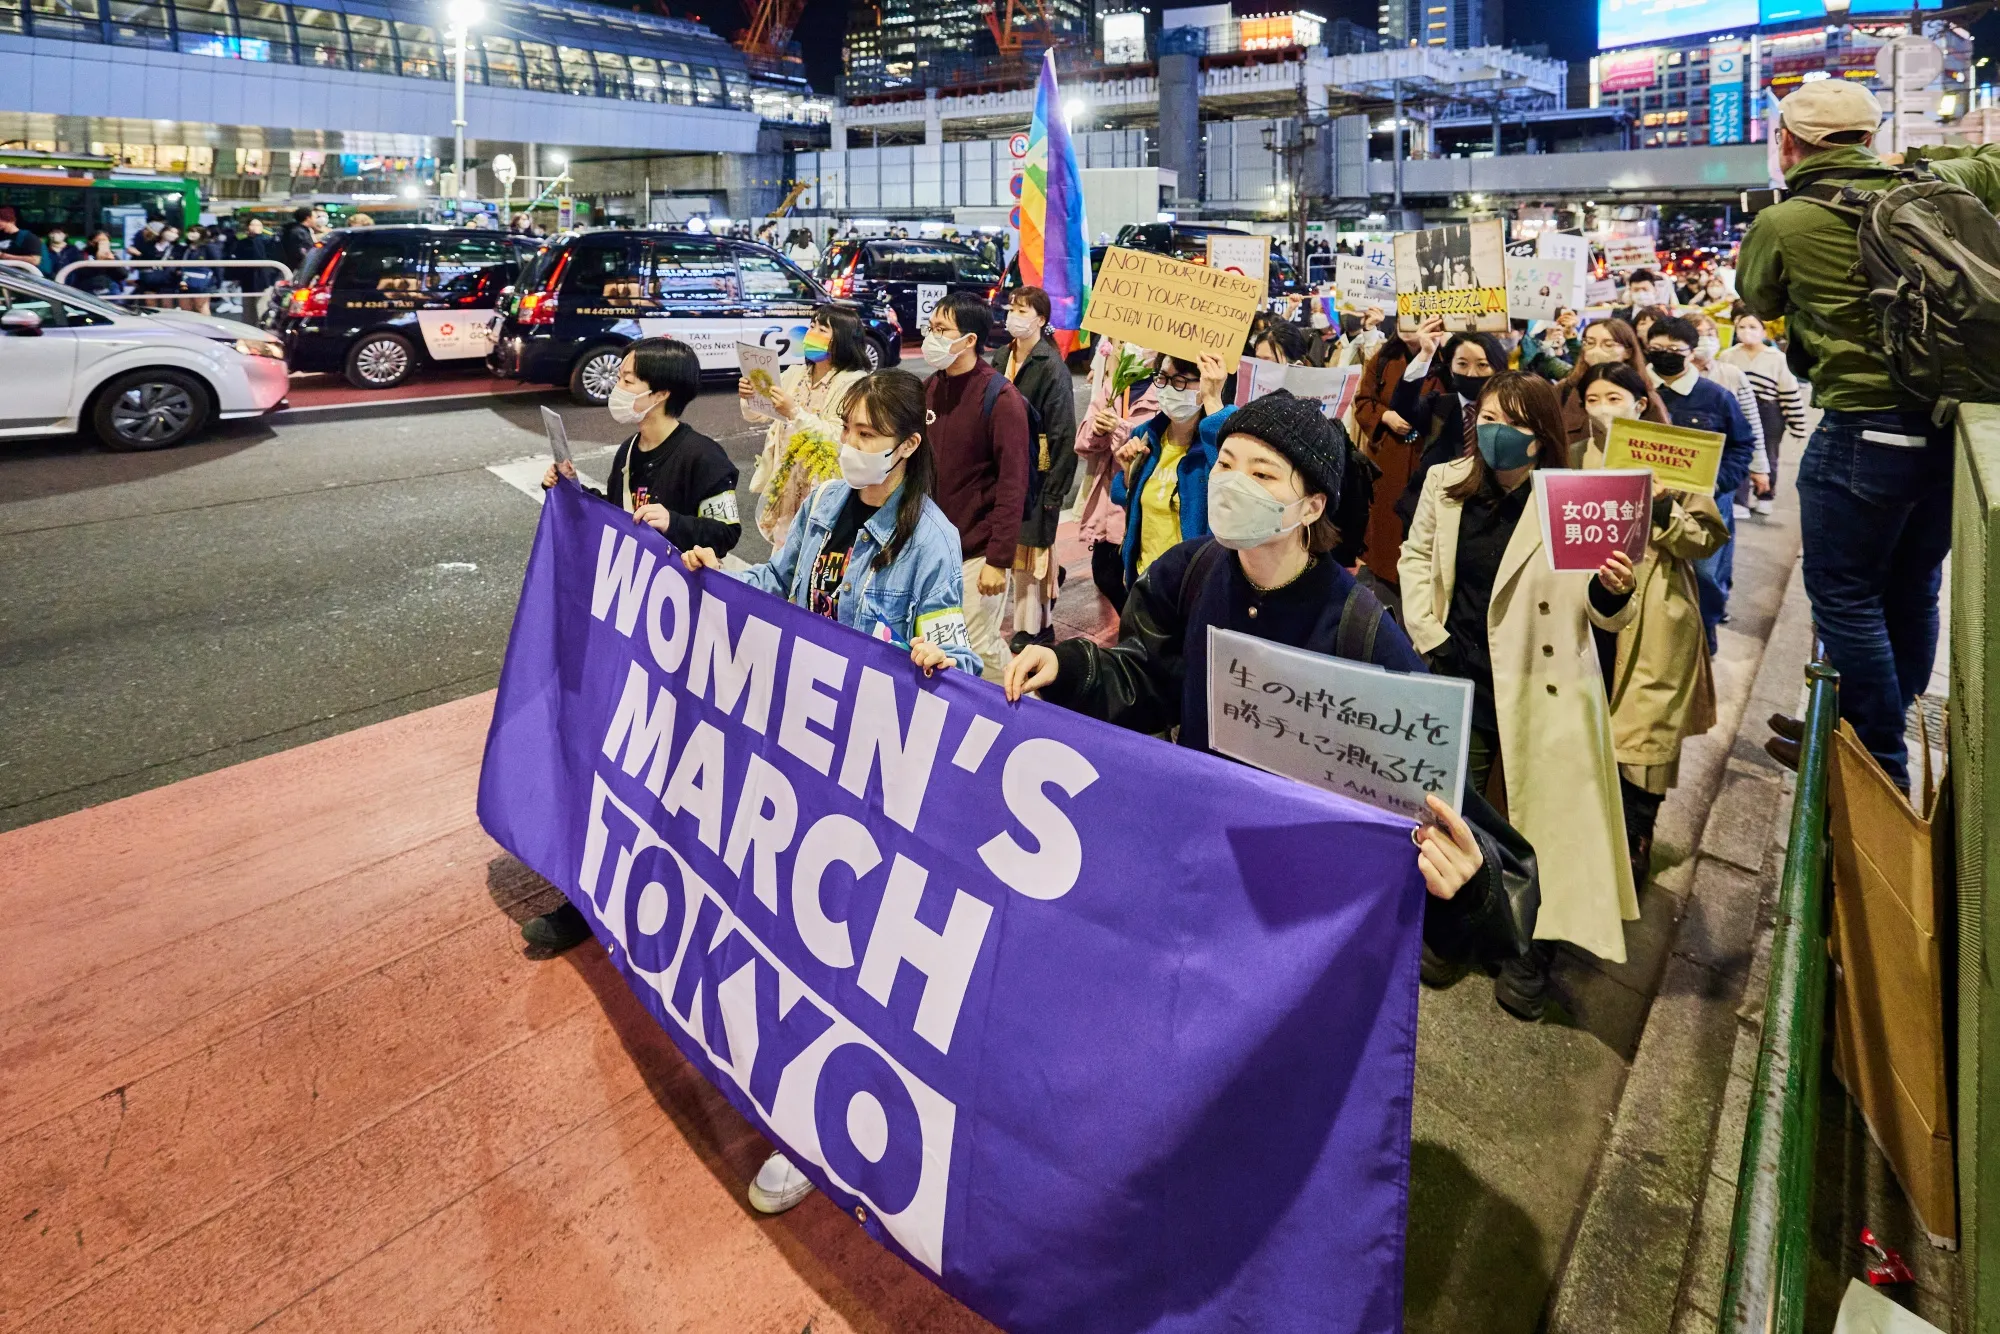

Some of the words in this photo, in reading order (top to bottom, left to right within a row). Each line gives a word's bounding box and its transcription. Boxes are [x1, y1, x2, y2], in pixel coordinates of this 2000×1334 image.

[1107, 252, 1147, 274] NOT
[1157, 259, 1199, 284] YOUR
[1200, 270, 1258, 299] UTERUS
[1089, 300, 1142, 326] LISTEN
[1147, 312, 1163, 332] TO
[1167, 318, 1234, 349] WOMEN!
[1100, 277, 1140, 298] NOT
[1147, 284, 1190, 309] YOUR
[1190, 296, 1252, 325] DECISION
[742, 351, 772, 367] STOP
[1628, 438, 1700, 459] RESPECT
[1631, 449, 1694, 469] WOMEN
[1561, 500, 1644, 521] 女の賃金は
[590, 525, 1101, 901] WOMEN'S
[1229, 658, 1449, 746] 生の枠組みを
[1344, 780, 1376, 798] AM
[601, 661, 994, 1055] MARCH
[593, 795, 924, 1216] TOKYO
